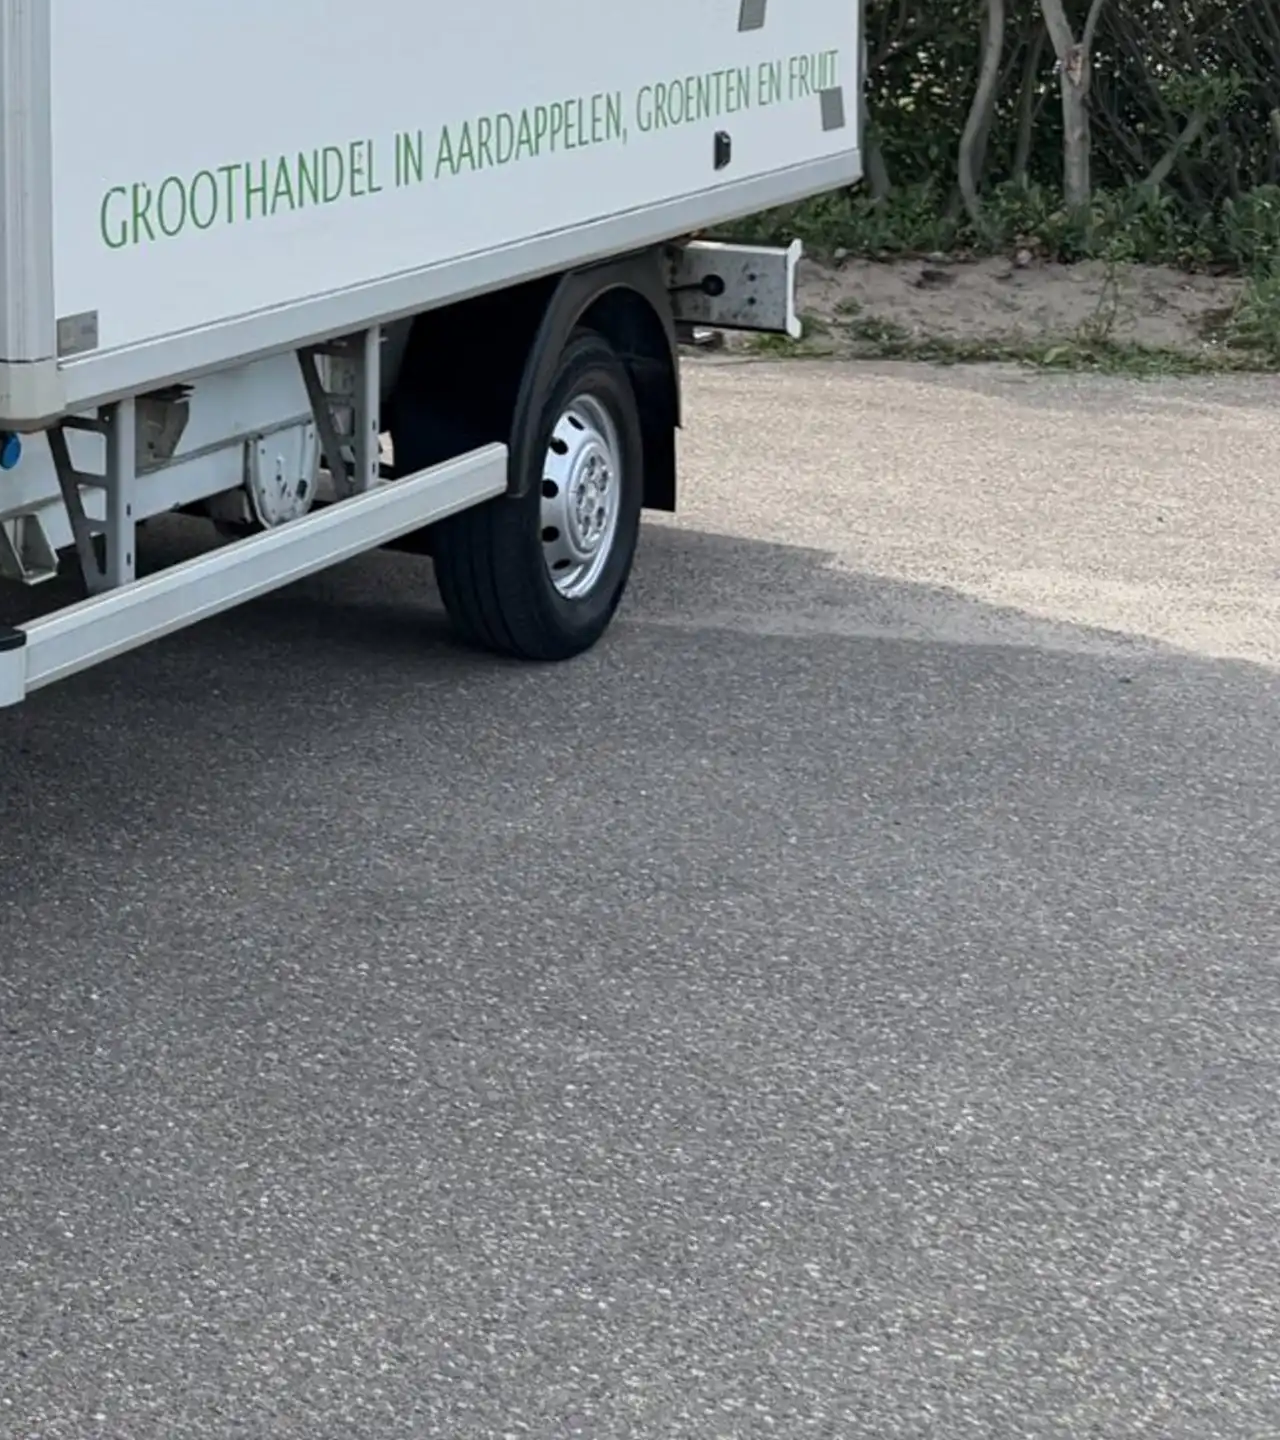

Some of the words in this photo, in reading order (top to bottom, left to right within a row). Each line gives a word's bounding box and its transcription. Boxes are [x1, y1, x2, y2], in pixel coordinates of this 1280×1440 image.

[100, 138, 383, 249] GROOTHANDEL
[395, 128, 424, 188] IN
[434, 90, 628, 180] AARDAPPELEN,
[636, 65, 751, 133] GROENTEN
[758, 59, 783, 106] EN
[788, 48, 839, 102] FRUIT
